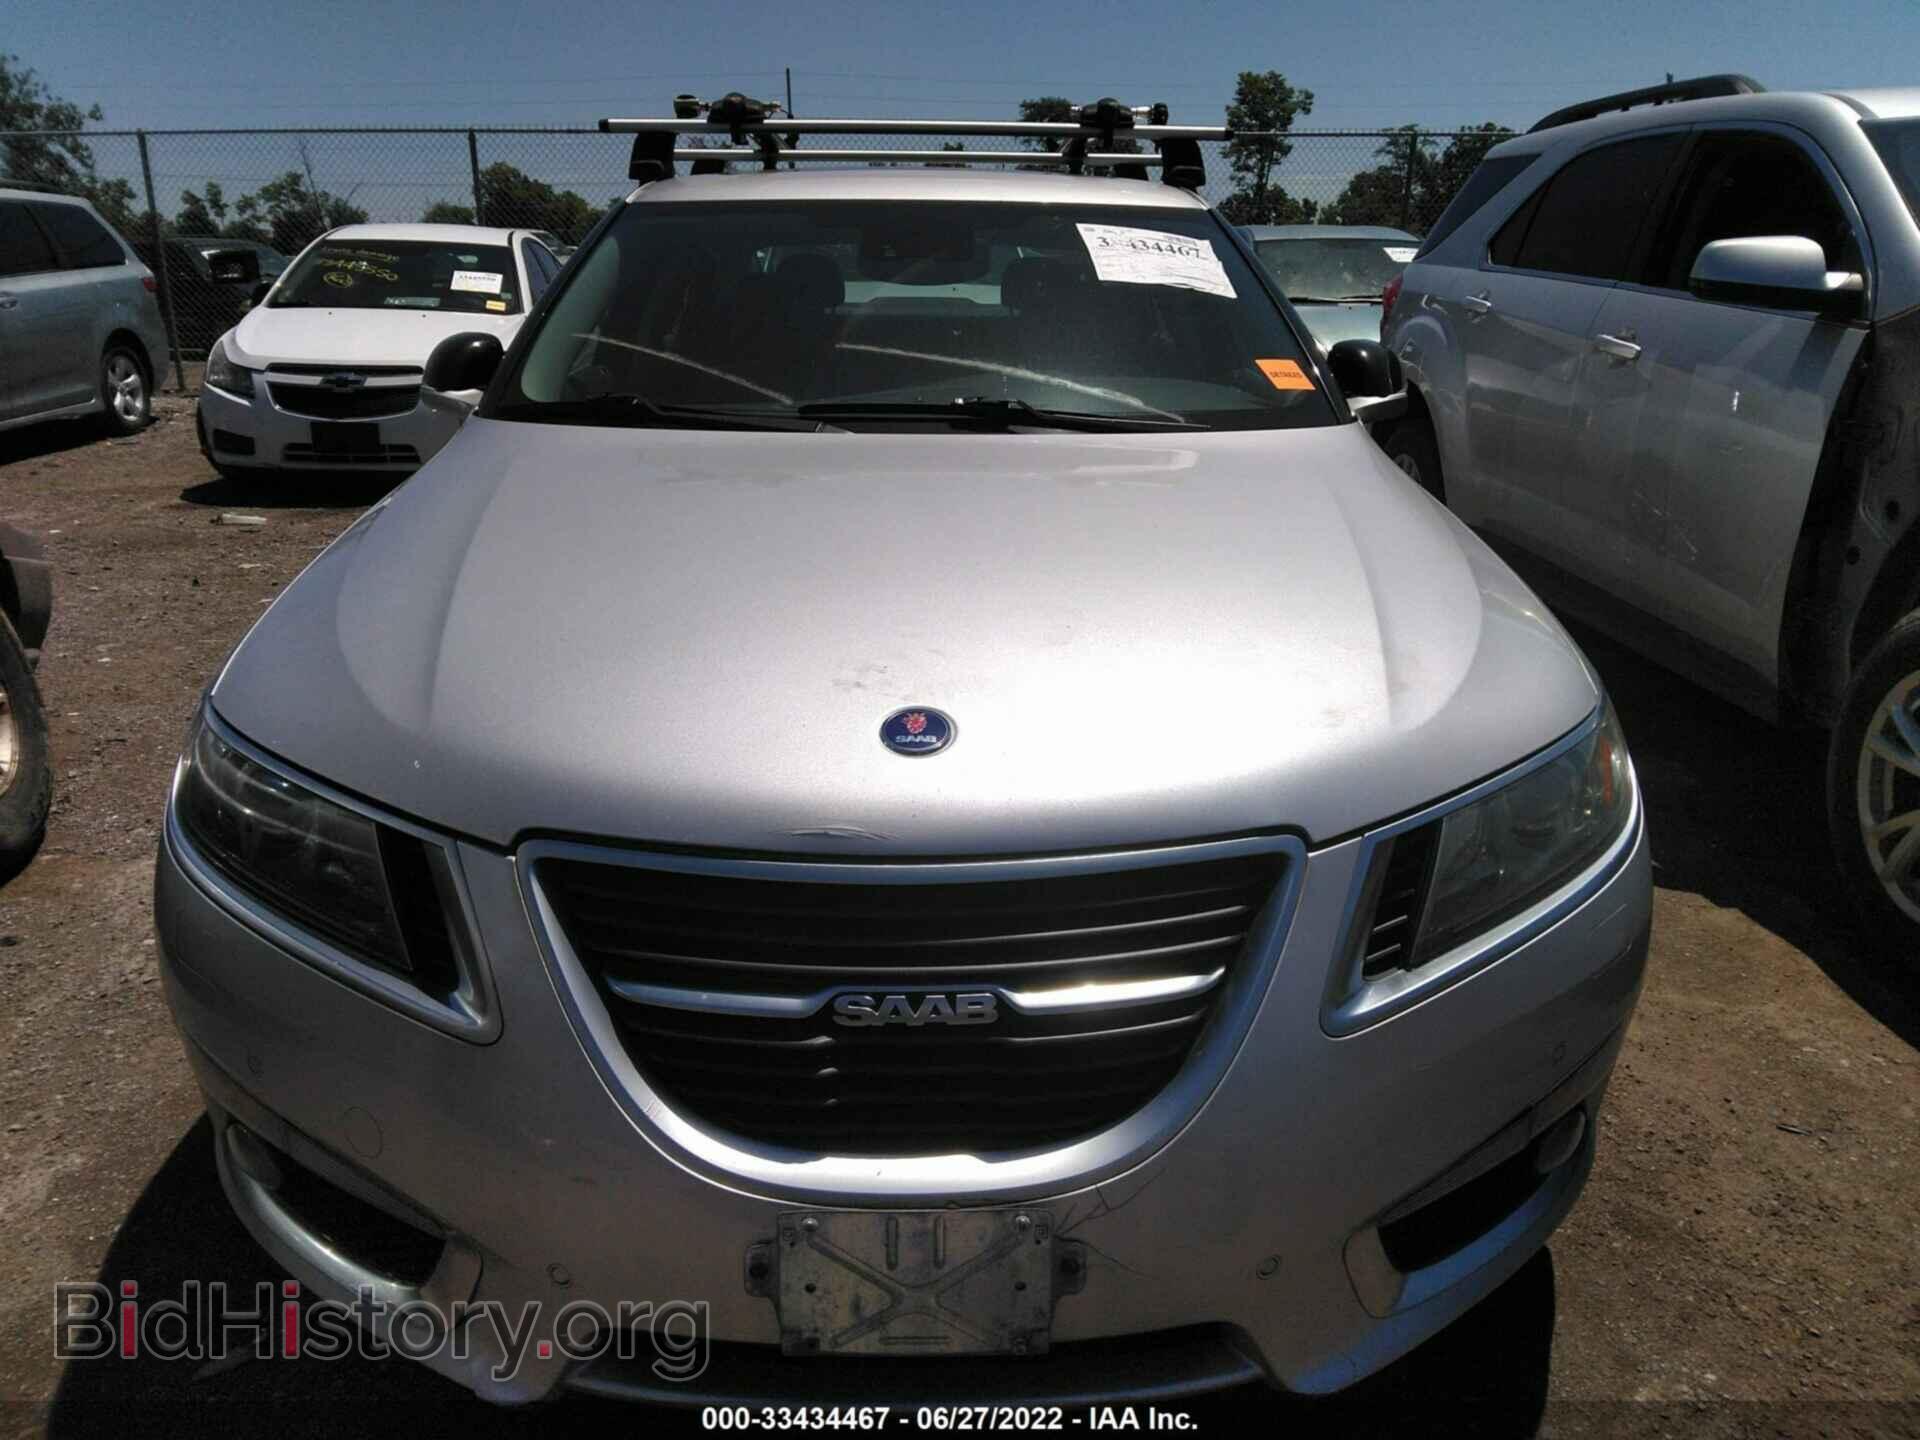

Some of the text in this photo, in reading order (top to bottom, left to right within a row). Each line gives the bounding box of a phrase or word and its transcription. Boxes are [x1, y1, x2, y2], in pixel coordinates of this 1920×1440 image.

[1096, 236, 1200, 259] 3434467
[895, 734, 937, 744] SAAB
[833, 993, 999, 1026] SAAB
